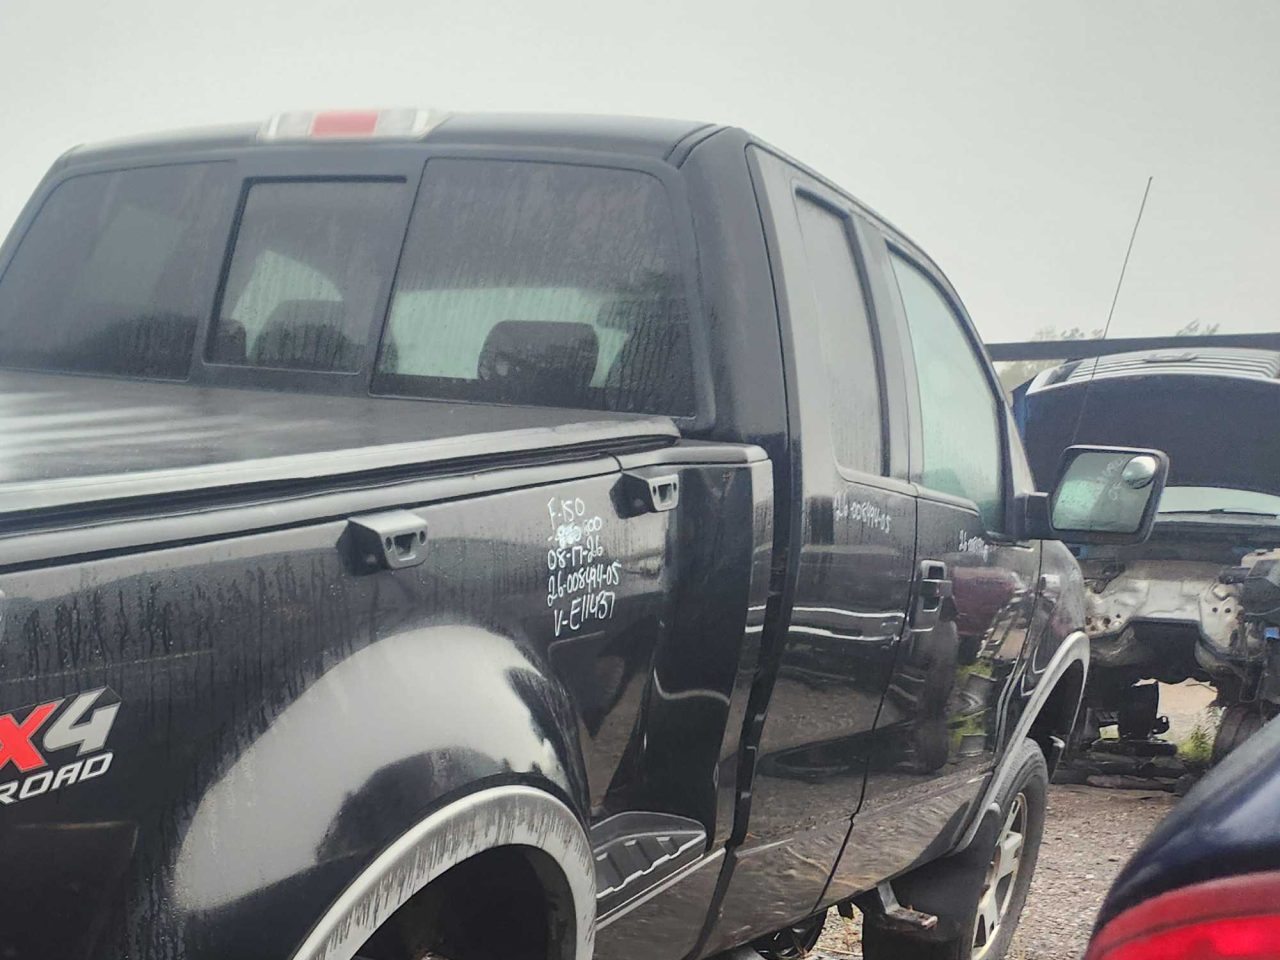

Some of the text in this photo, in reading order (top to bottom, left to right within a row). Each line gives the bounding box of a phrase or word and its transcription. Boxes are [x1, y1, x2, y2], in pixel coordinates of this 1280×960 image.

[547, 497, 585, 531] F-150
[547, 534, 603, 570] 08-17-26
[546, 560, 622, 607] 26-008494-05
